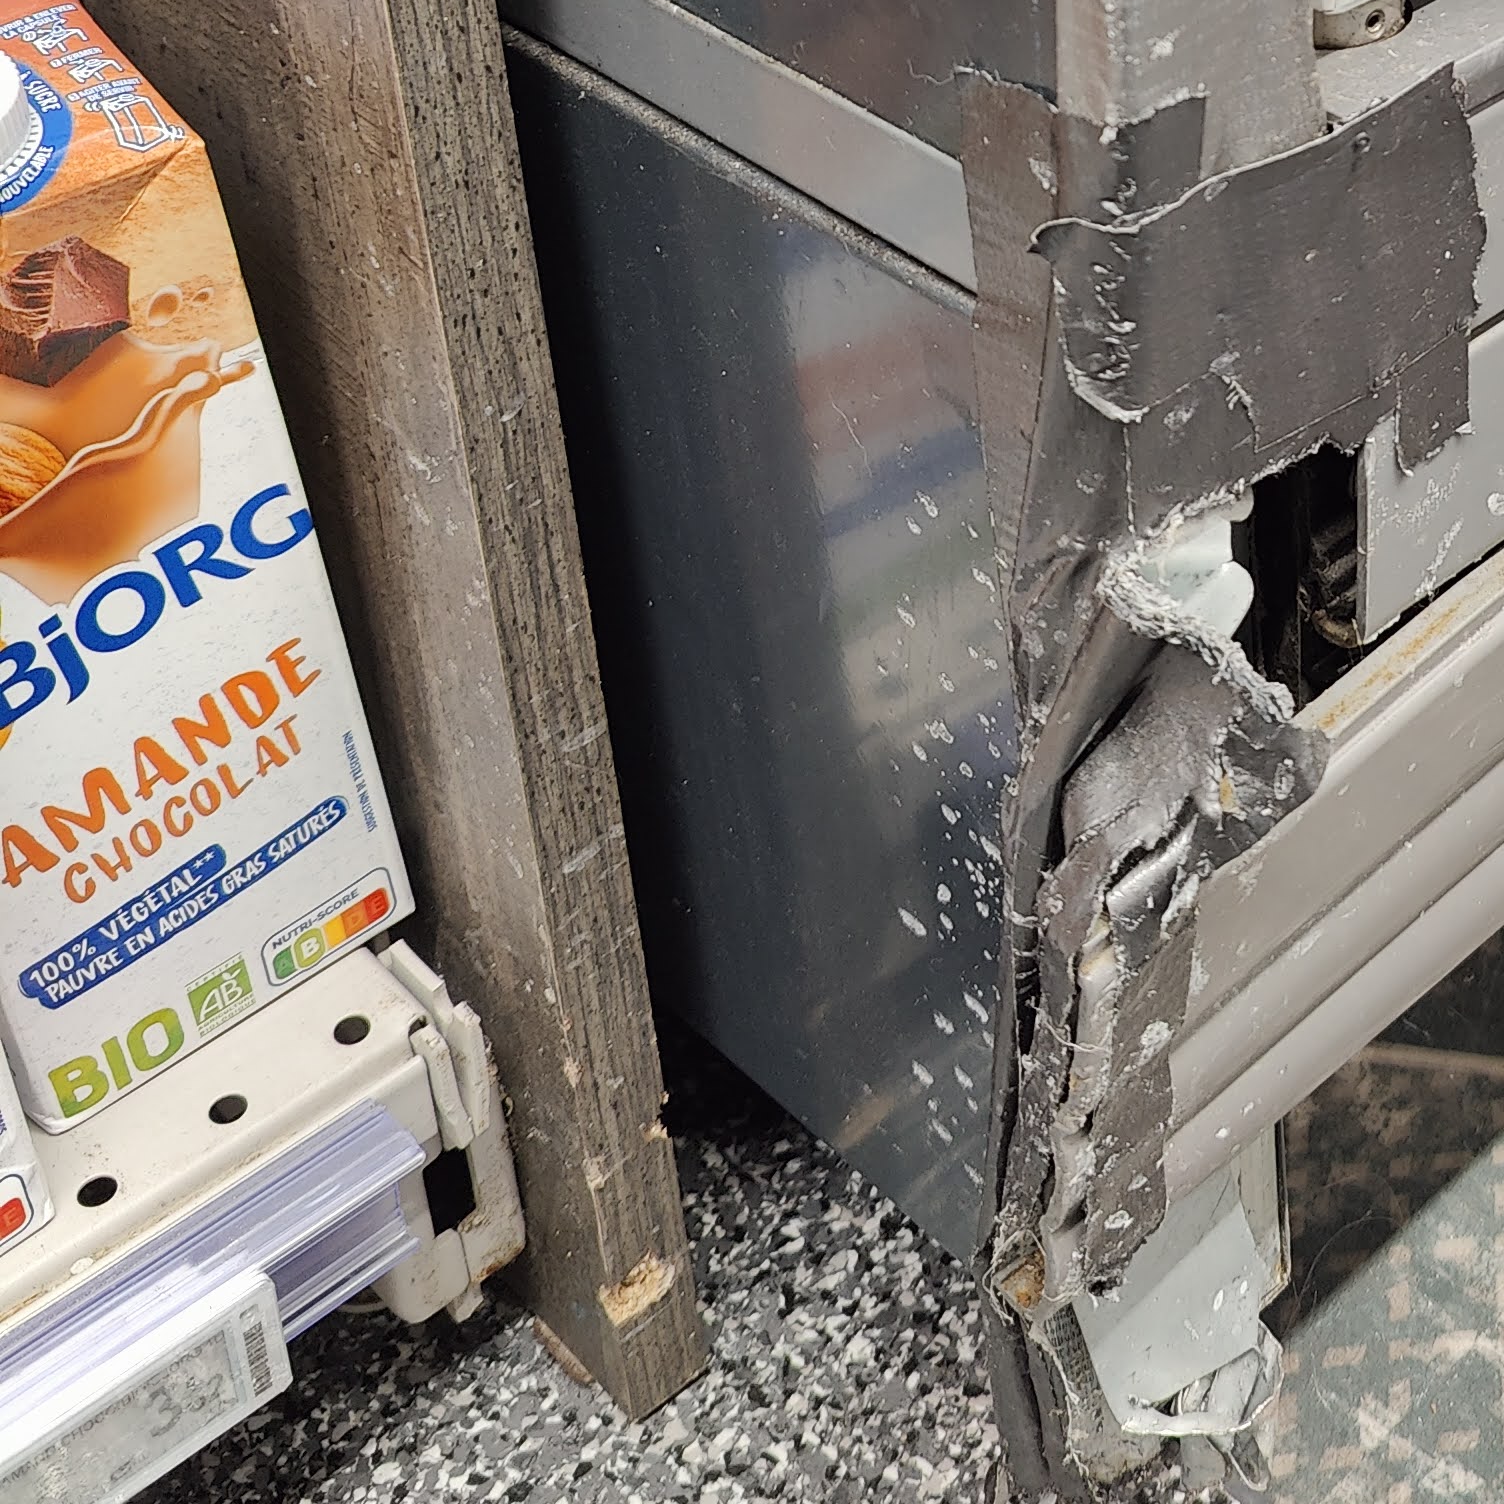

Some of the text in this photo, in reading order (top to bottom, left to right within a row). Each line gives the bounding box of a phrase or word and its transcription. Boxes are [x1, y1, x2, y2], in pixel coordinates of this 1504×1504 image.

[25, 80, 62, 112] SUCRE
[2, 637, 322, 888] AMANDE
[64, 714, 302, 903] CHOCOLAT
[44, 799, 341, 1003] PAUVRE EN ACIDES GRAS SATURÉS
[272, 887, 359, 950] NUTRI-SCORE
[29, 938, 97, 988] 100%
[300, 936, 320, 960] B
[200, 978, 243, 1022] AB
[47, 1007, 185, 1119] BIO
